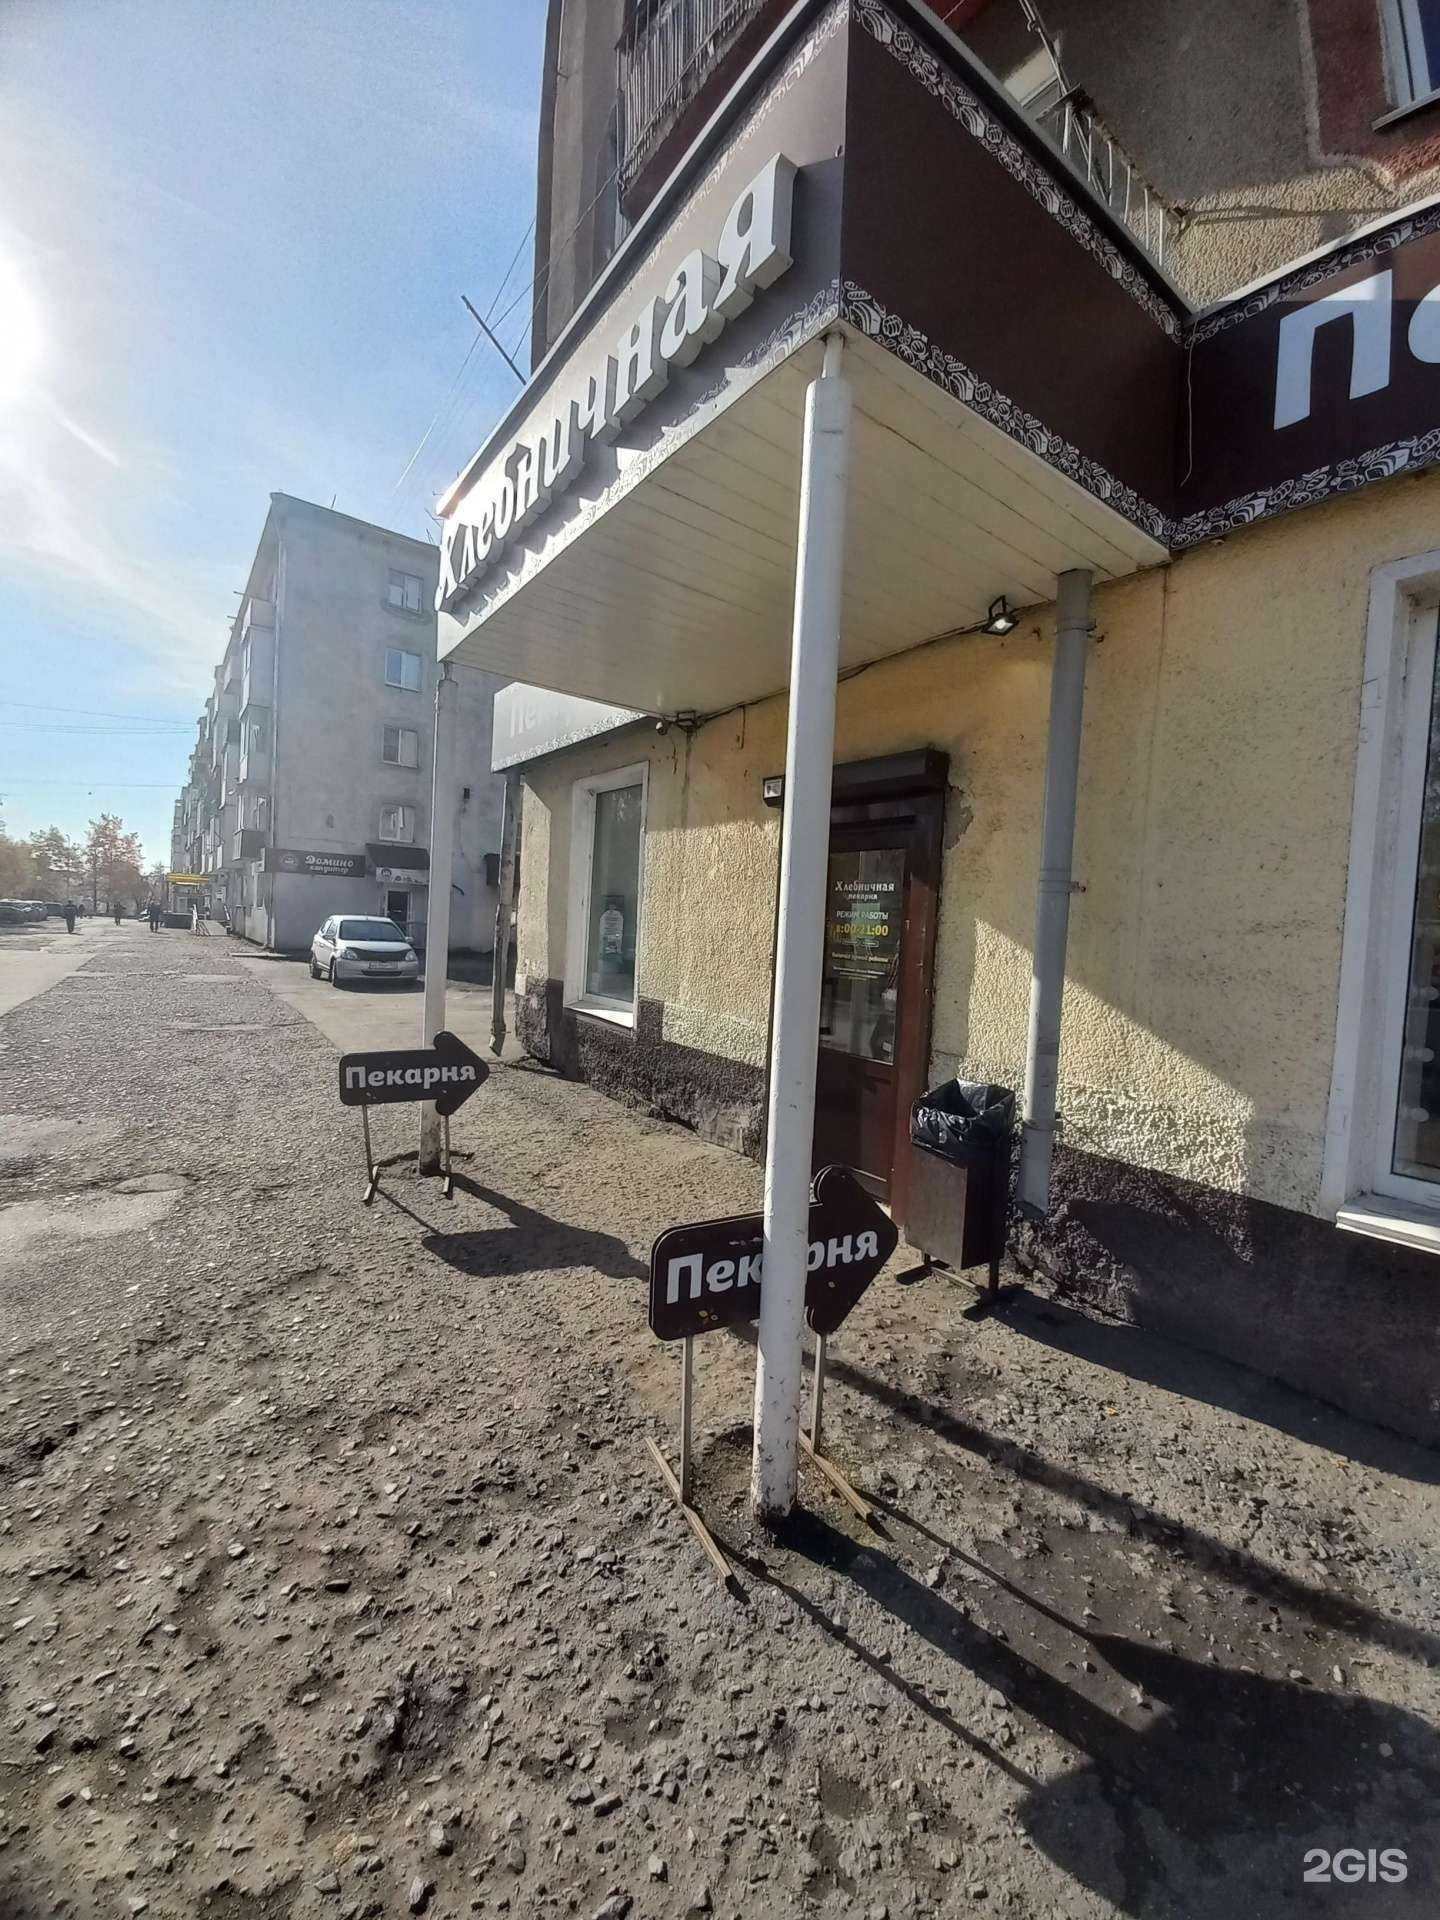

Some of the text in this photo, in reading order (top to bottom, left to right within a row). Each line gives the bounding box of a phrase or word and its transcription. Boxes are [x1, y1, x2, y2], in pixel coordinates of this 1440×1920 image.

[305, 855, 354, 867] Домино
[835, 880, 895, 891] Хлебничная
[345, 1065, 477, 1089] Пекарня
[666, 1230, 879, 1304] Пекрня
